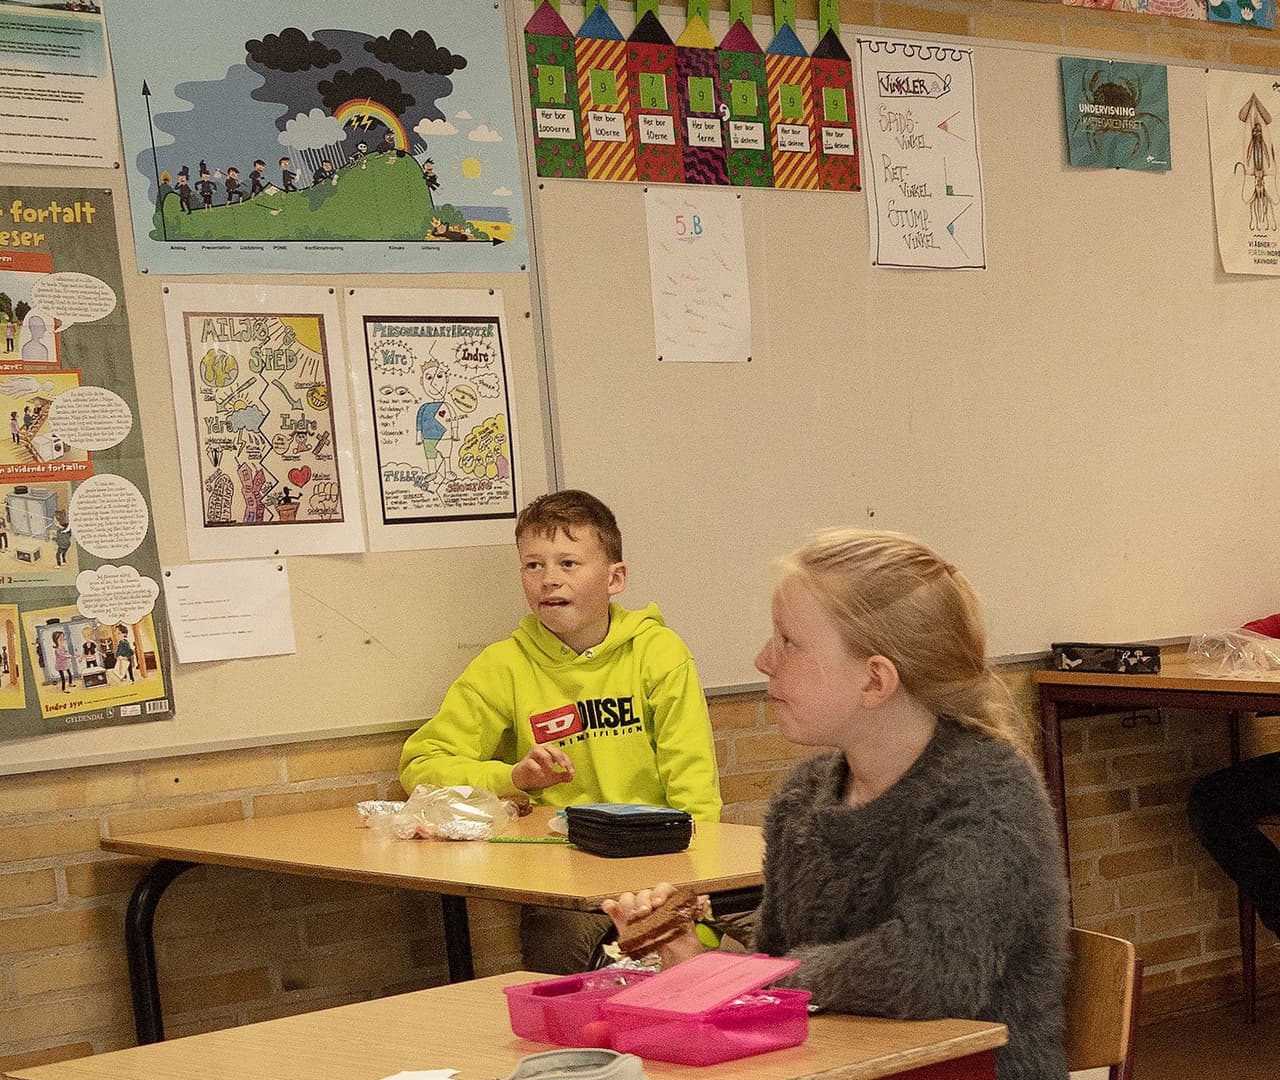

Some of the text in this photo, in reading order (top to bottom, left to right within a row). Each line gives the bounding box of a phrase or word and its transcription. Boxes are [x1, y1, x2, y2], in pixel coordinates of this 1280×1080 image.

[1079, 103, 1136, 117] UNDERVISNING
[10, 200, 96, 224] fortalt
[249, 347, 298, 373] STED
[461, 347, 489, 363] Indre
[65, 712, 105, 725] GYLDENDAL
[577, 696, 641, 731] DIESEL
